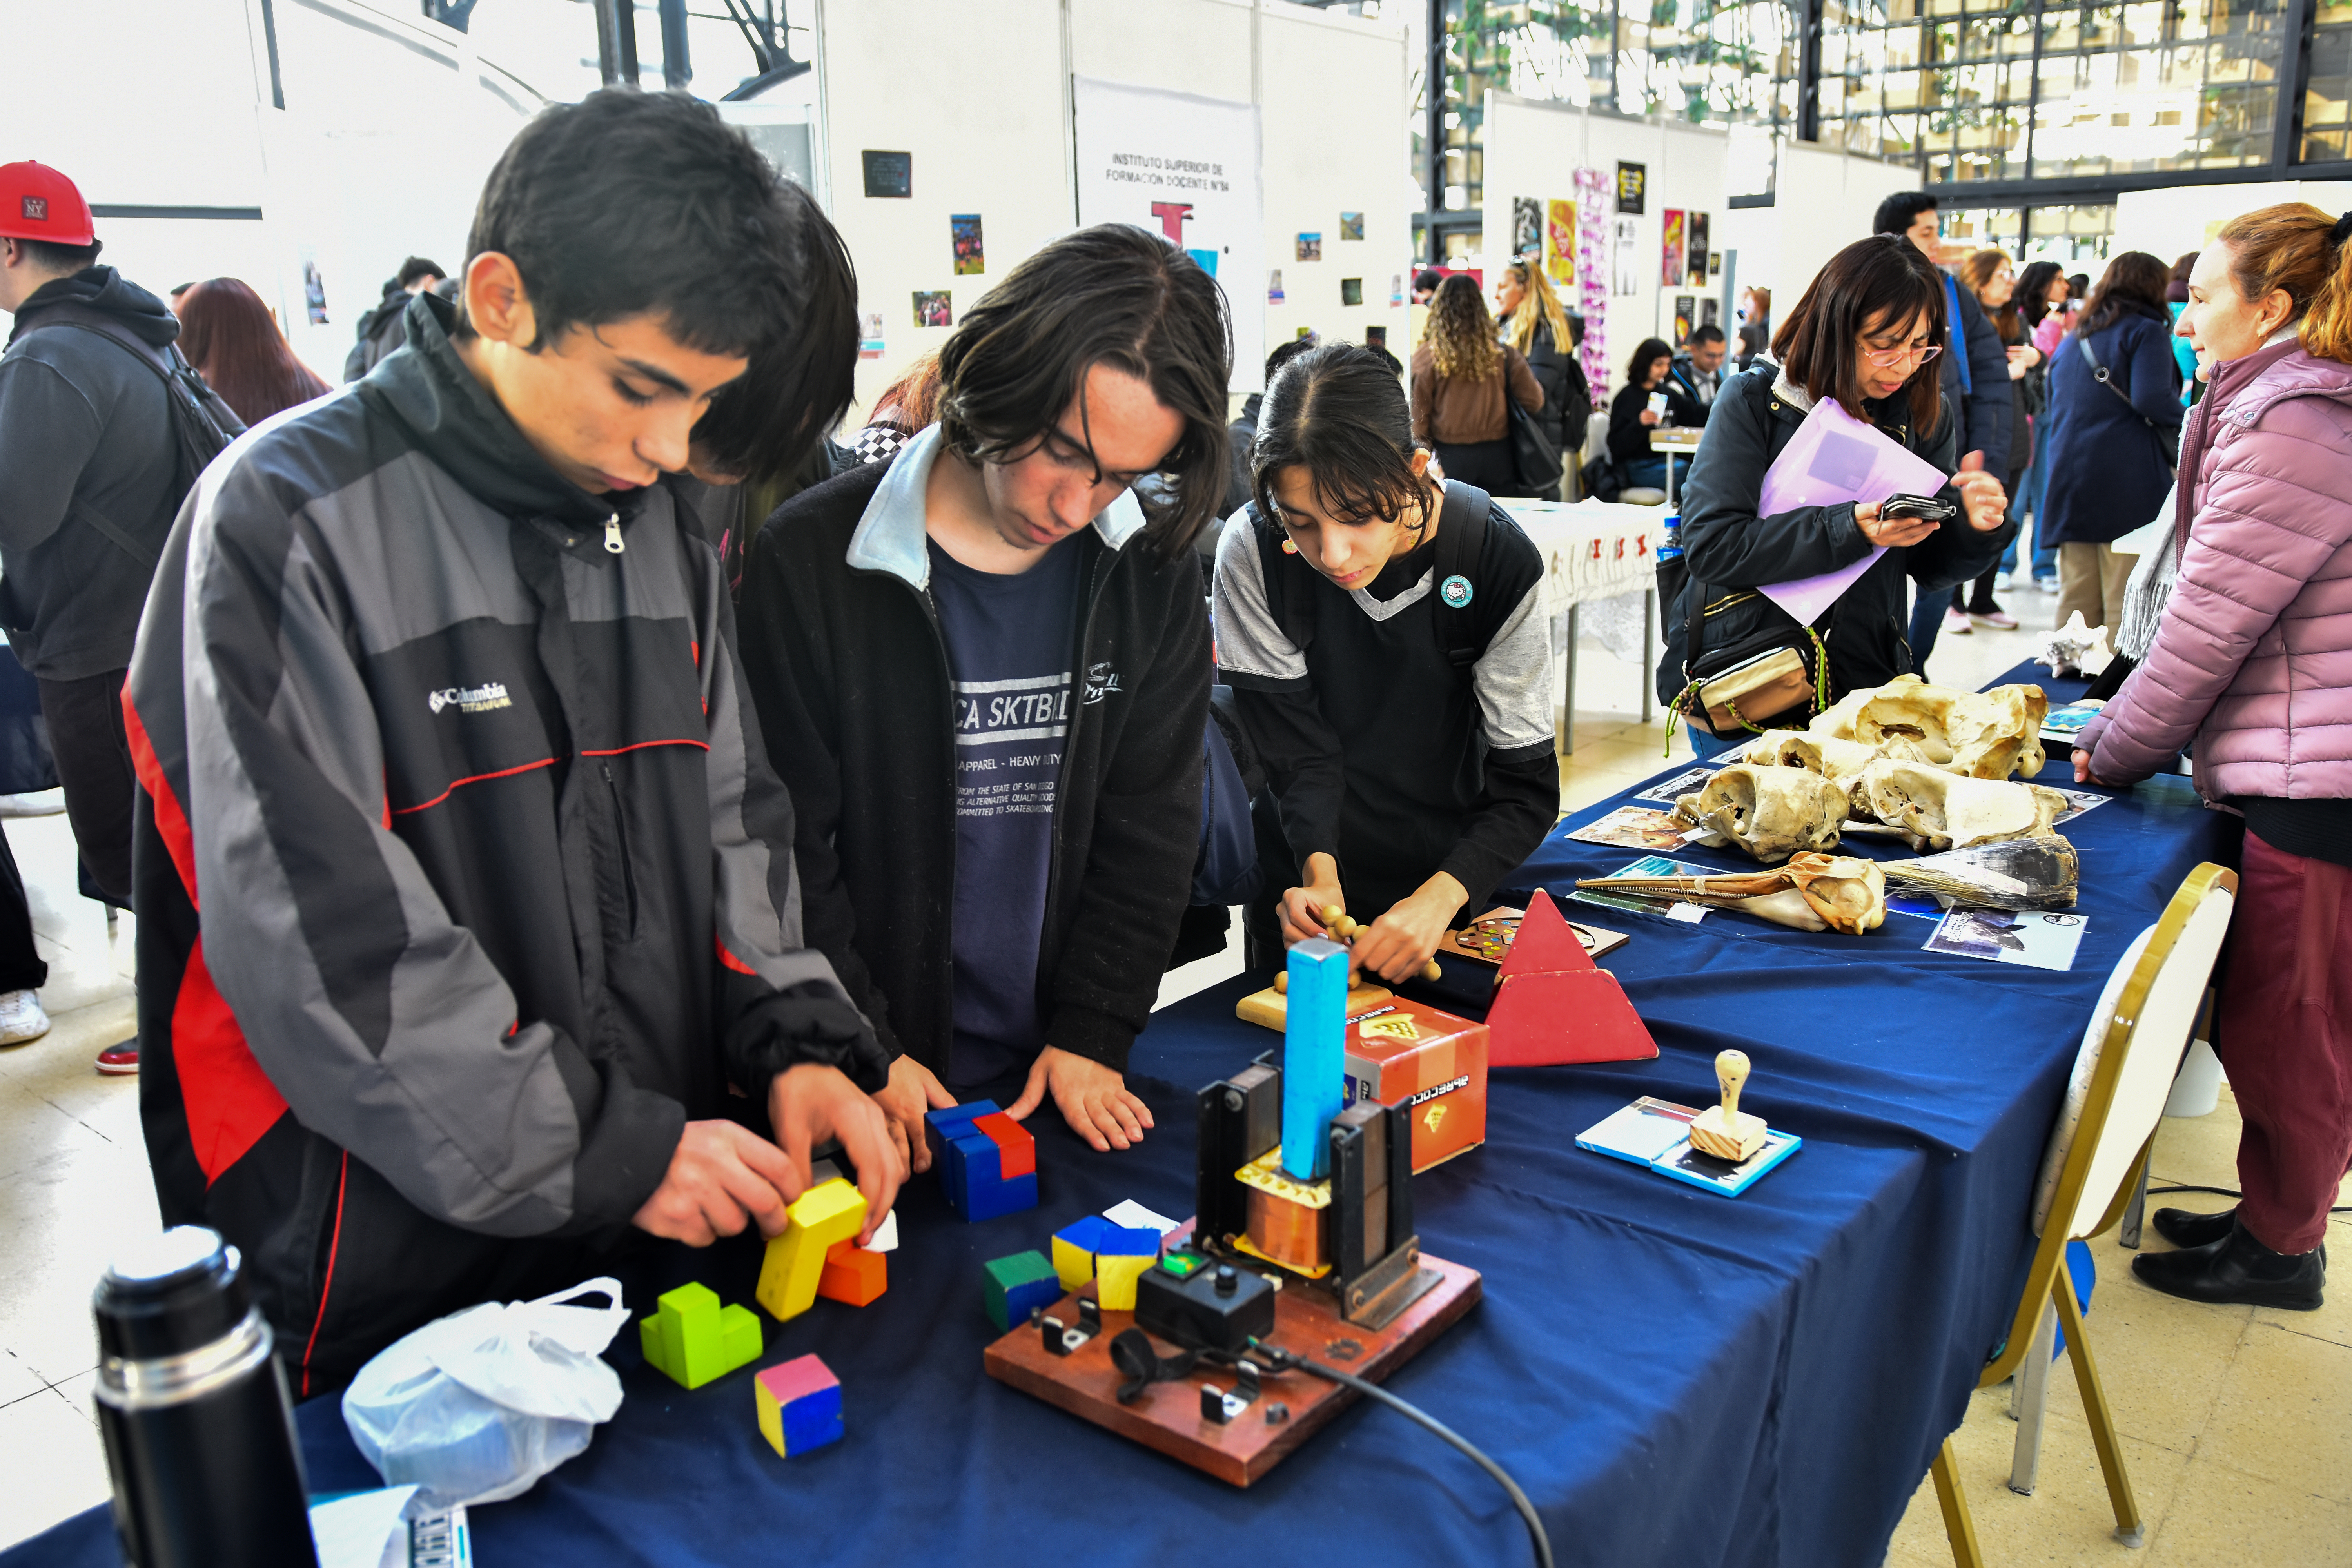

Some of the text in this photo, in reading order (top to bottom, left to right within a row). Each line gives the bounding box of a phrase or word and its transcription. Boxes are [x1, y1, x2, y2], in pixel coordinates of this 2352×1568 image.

[1112, 152, 1223, 176] INSTITUTO SUPERIOR DE
[1166, 175, 1208, 190] DOCENTE
[27, 204, 42, 213] NY
[1442, 579, 1450, 592] HELLO
[445, 682, 507, 704] Columbia
[460, 697, 512, 712] TITANIUM
[958, 759, 997, 771] APPAREL
[1009, 755, 1041, 767] HEAVY
[978, 786, 990, 795] THE
[992, 783, 1010, 793] STATE
[1012, 782, 1022, 791] OF
[1024, 782, 1037, 791] SAN
[966, 794, 1009, 805] ALTERNATIVE
